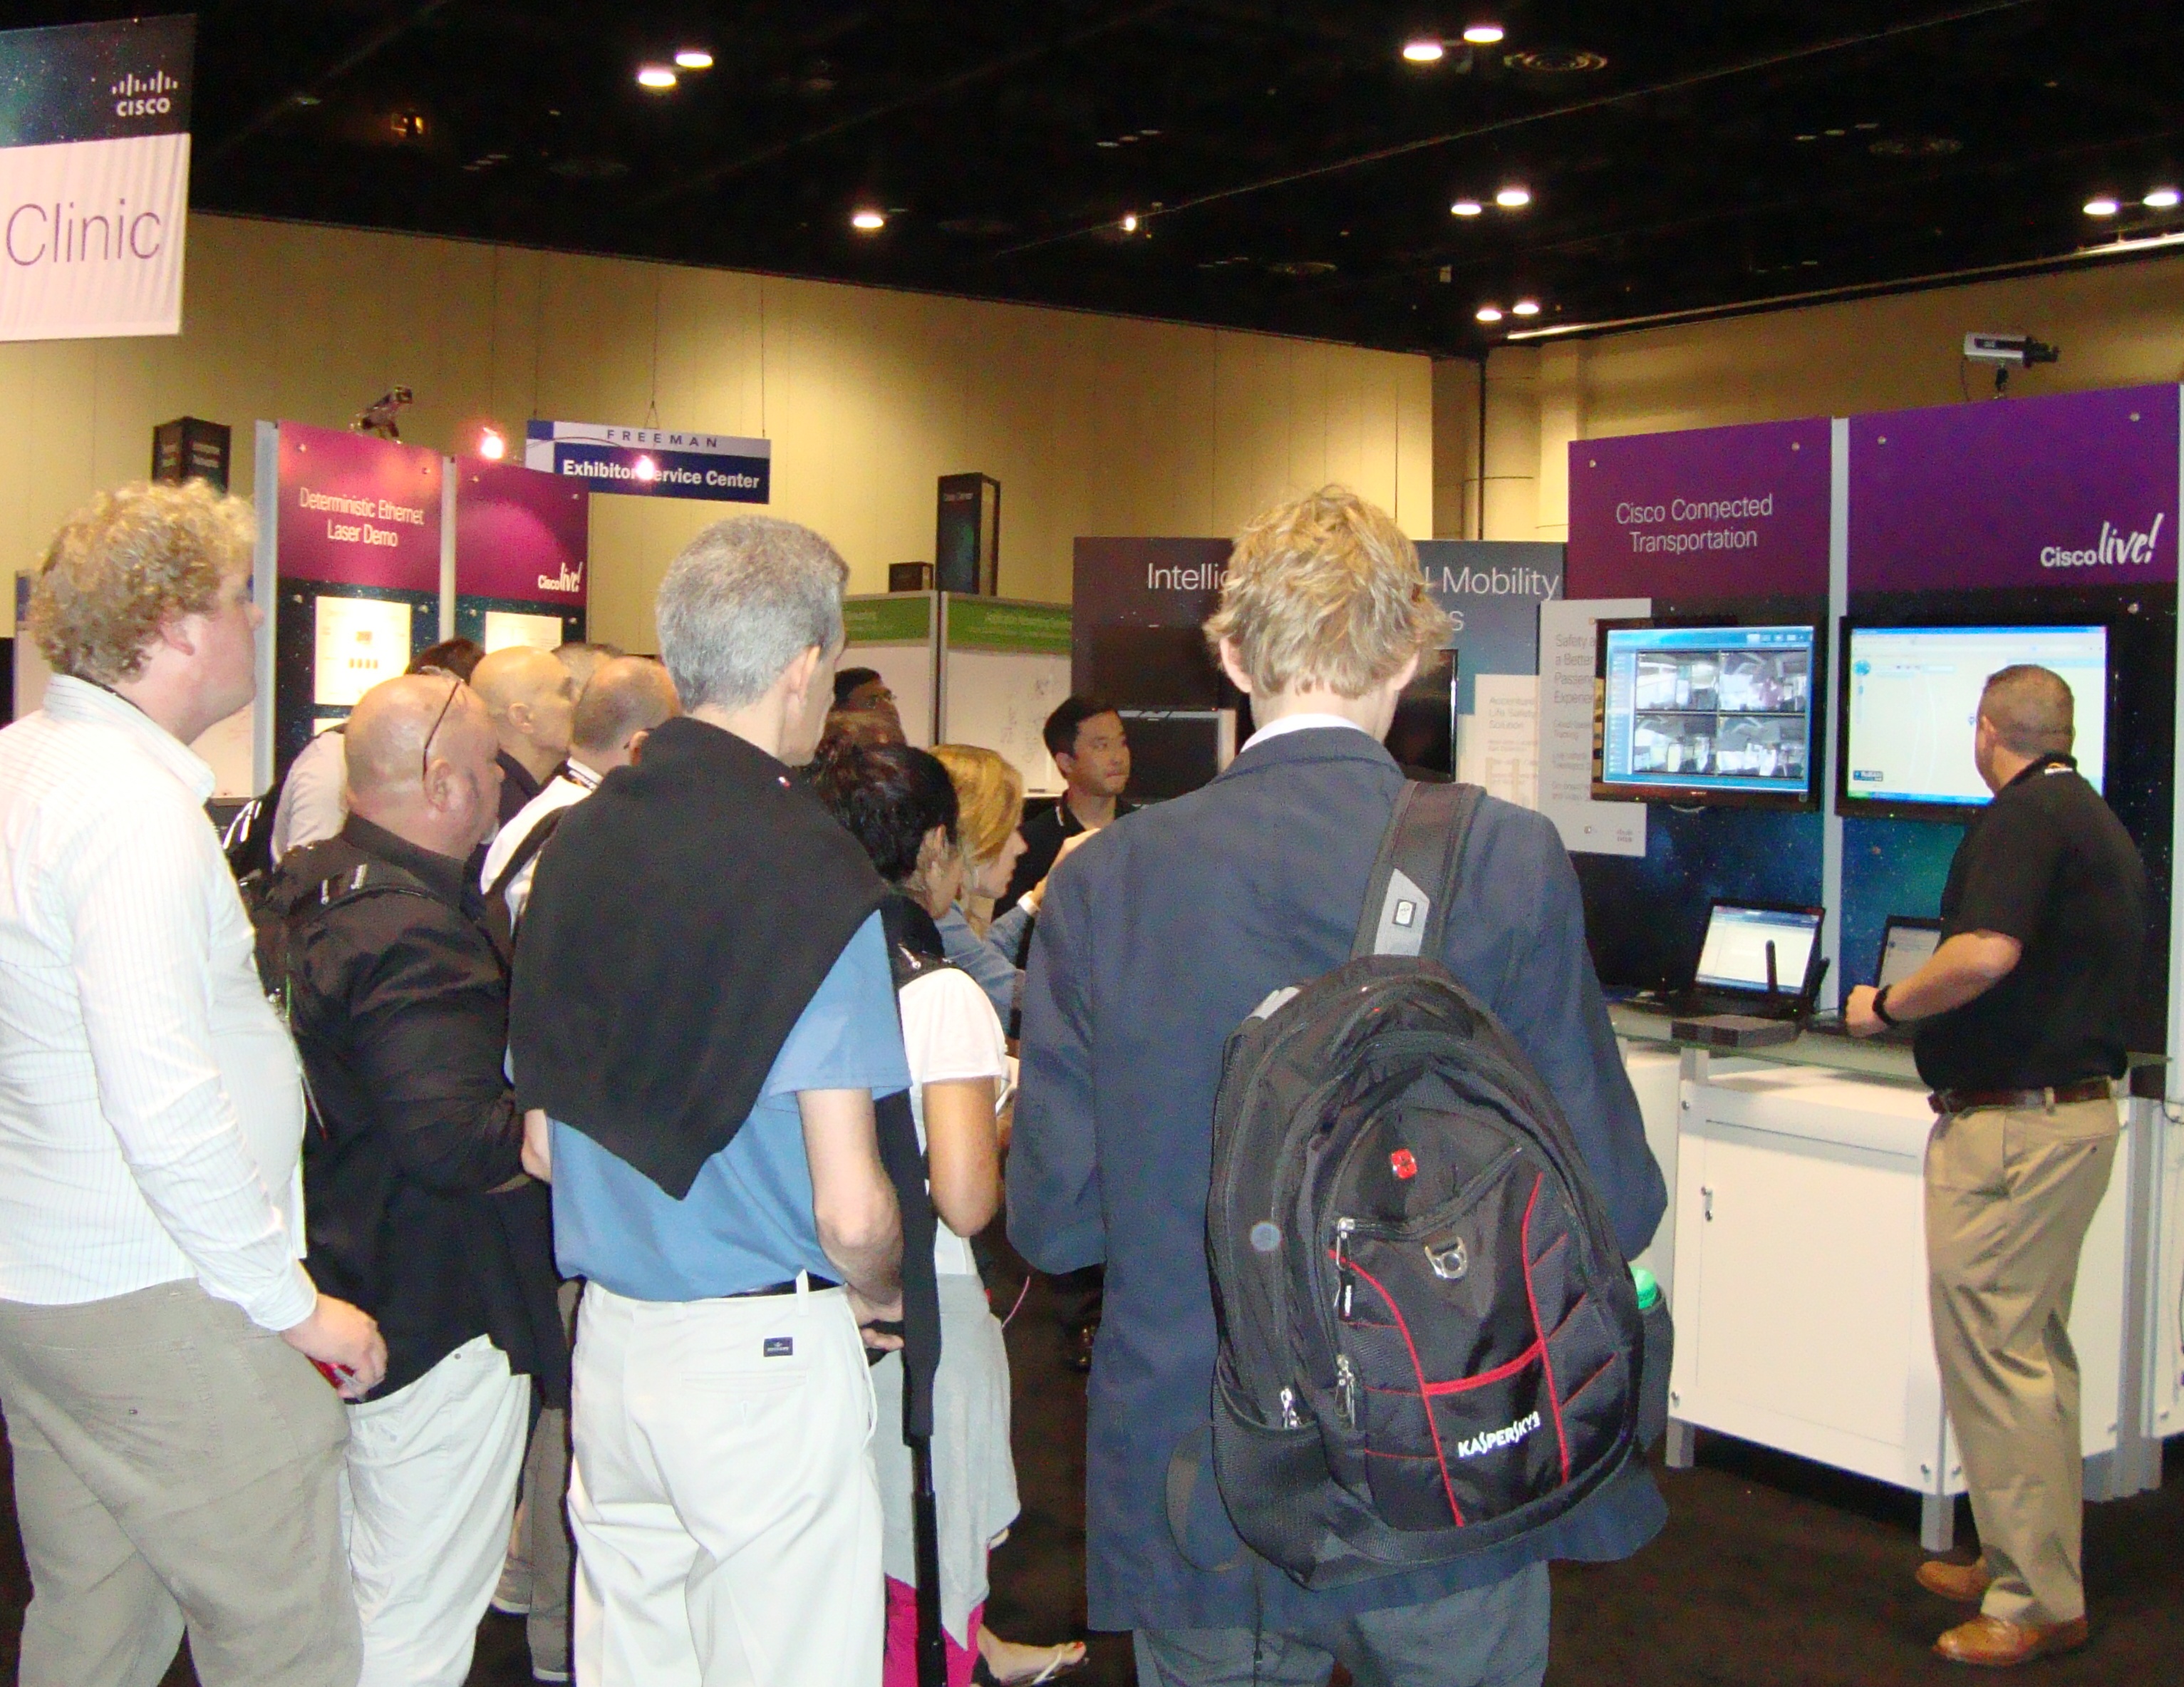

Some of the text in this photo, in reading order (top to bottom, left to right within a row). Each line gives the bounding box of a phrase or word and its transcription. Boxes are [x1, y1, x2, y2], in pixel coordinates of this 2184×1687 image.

[6, 198, 161, 267] Clinic
[607, 429, 718, 448] FREEMAN
[651, 467, 702, 485] ervice
[706, 470, 760, 488] Center
[299, 487, 425, 525] Deterministic Ethernet
[1616, 493, 1773, 525] Cisco Connected
[327, 519, 398, 547] Laser Demo
[1629, 526, 1759, 555] Transportation
[1442, 566, 1560, 600] Mobility
